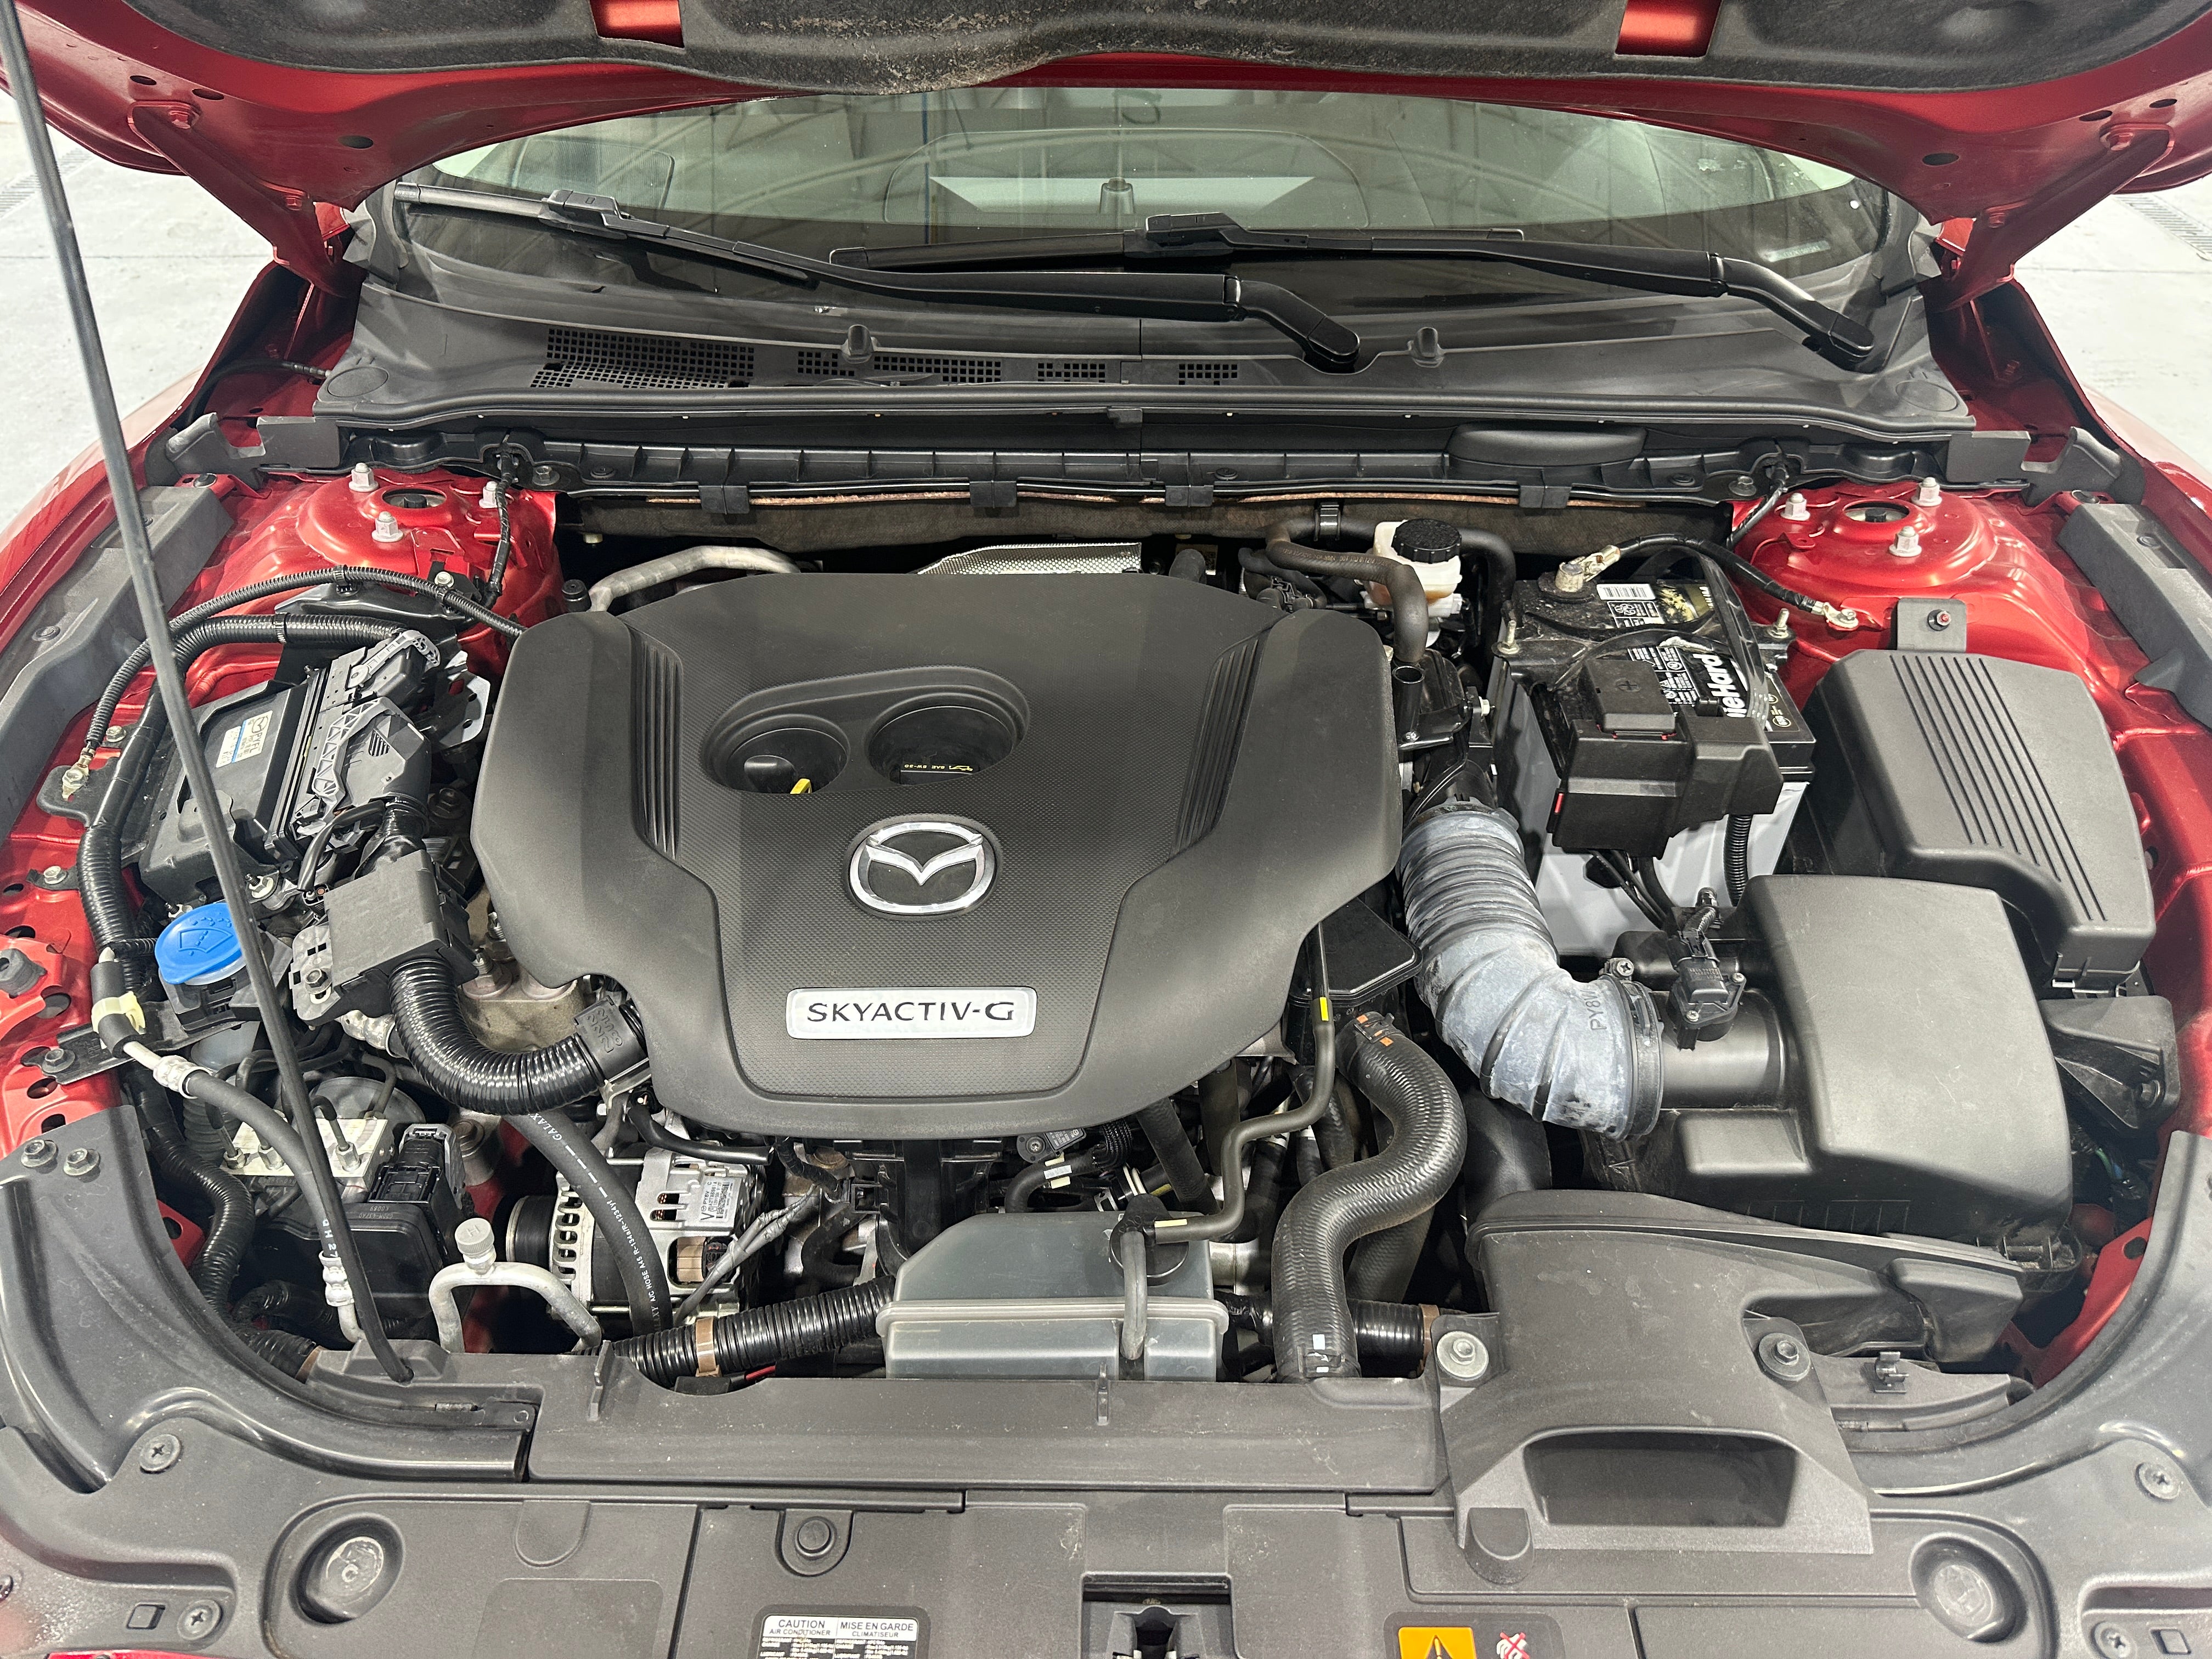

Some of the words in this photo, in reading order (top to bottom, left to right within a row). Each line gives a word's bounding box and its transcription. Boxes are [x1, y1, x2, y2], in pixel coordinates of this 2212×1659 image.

[1692, 653, 1747, 718] ieHard
[807, 1001, 1015, 1022] SKYACTIV-G
[528, 1113, 562, 1141] GALAX
[466, 1224, 480, 1238] H
[642, 1269, 652, 1289] HOSE
[648, 1290, 656, 1302] A/C
[778, 1619, 825, 1628] CAUTION
[840, 1622, 863, 1630] MISE
[865, 1622, 878, 1630] EN
[880, 1622, 914, 1632] GARDE
